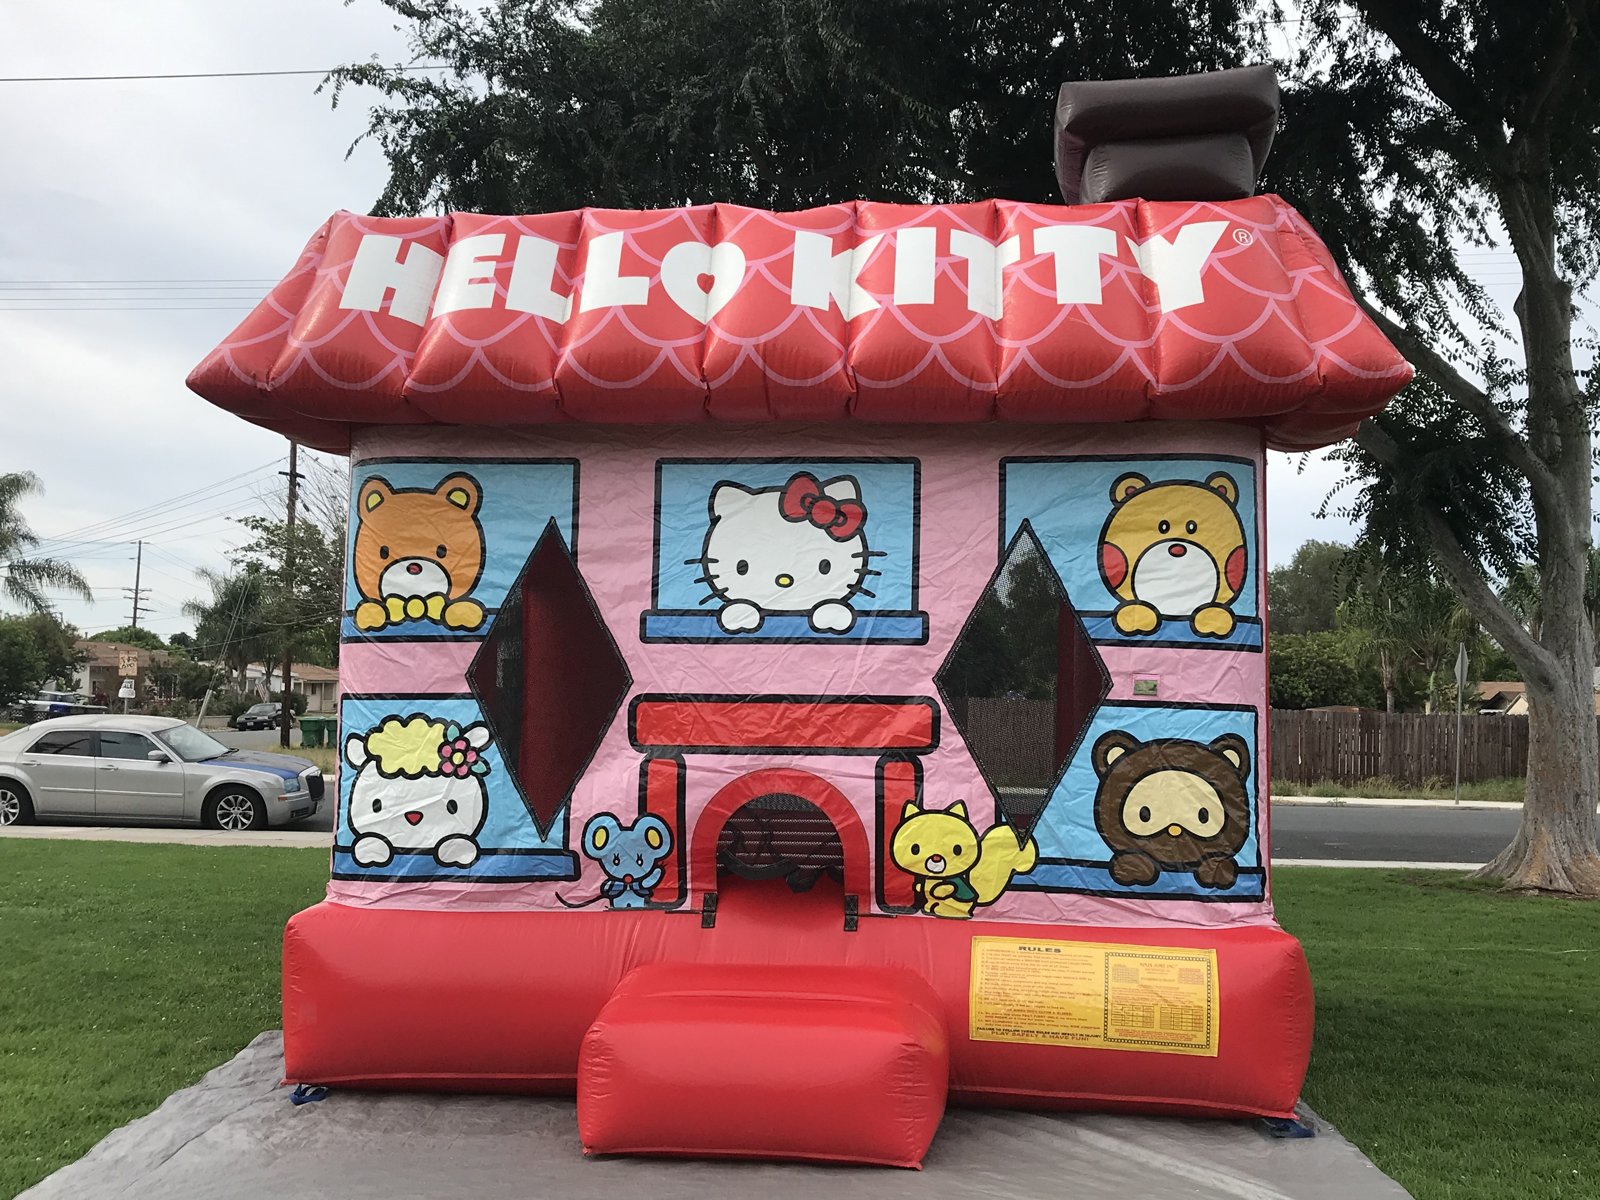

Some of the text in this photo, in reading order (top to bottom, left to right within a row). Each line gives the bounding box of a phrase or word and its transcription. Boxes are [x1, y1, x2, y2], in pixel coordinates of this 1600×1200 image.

[339, 231, 746, 326] HELLO
[791, 221, 1230, 321] KITTY
[1018, 946, 1062, 954] RULES
